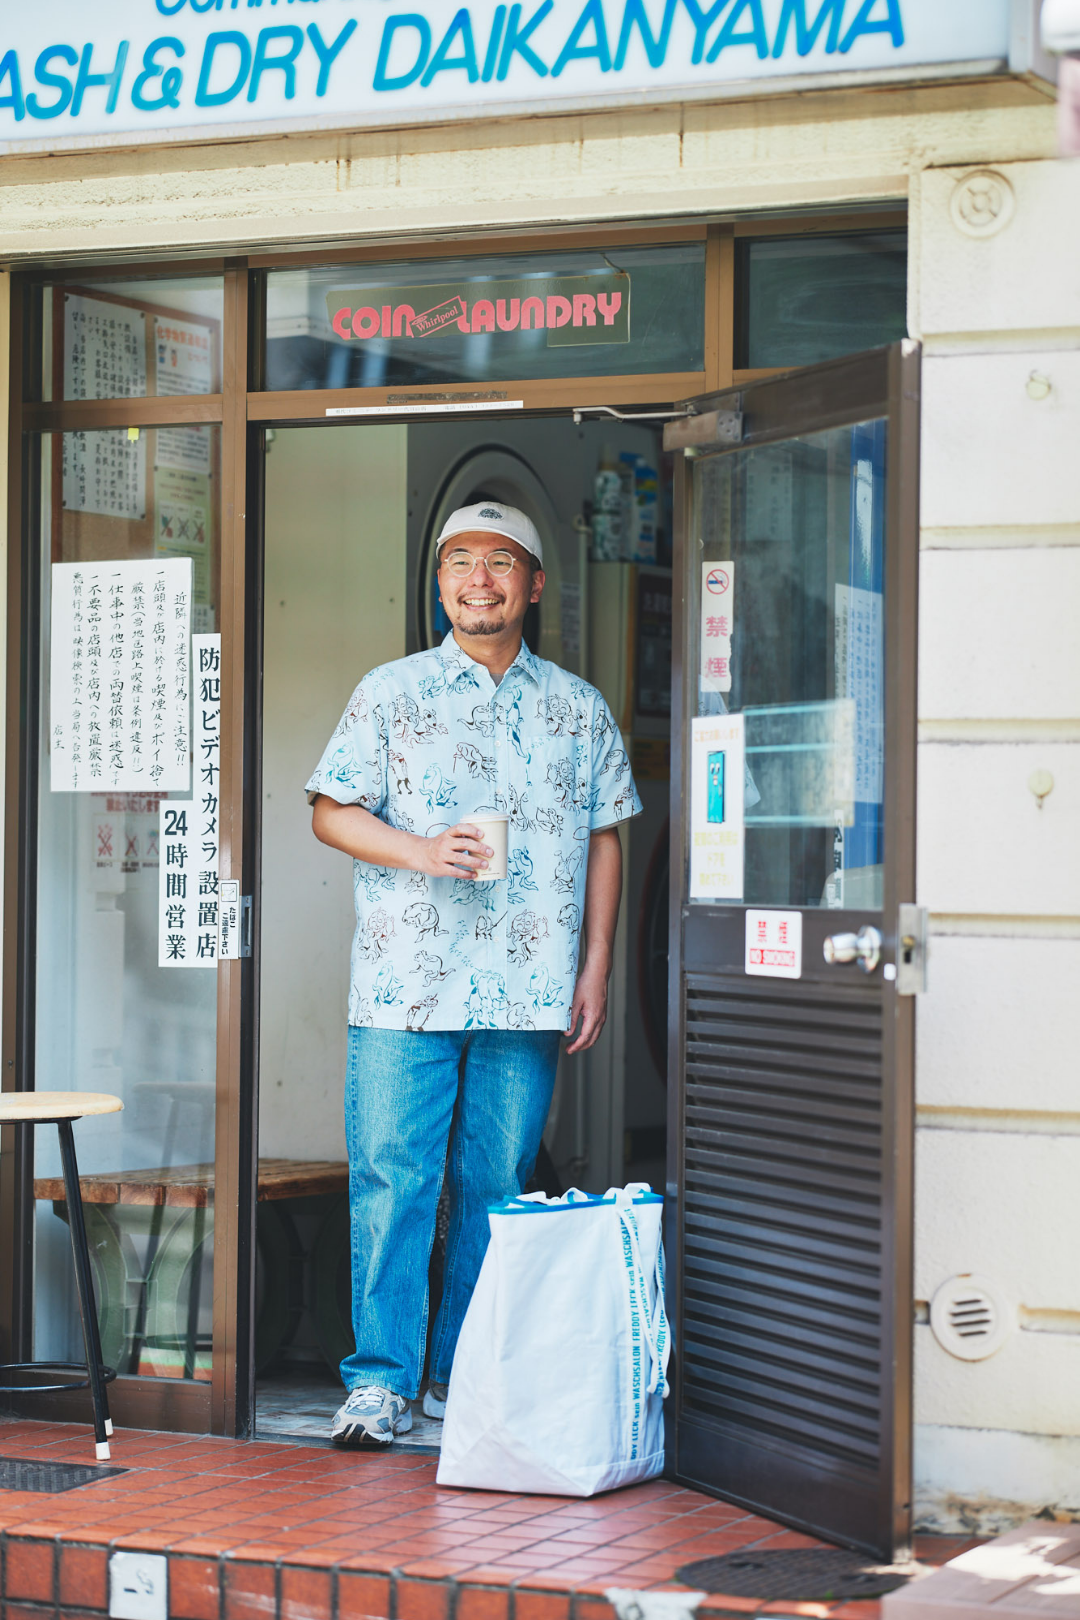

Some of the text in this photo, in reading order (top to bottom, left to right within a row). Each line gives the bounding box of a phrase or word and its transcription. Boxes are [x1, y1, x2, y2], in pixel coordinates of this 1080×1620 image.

[195, 18, 358, 107] DRY
[373, 0, 905, 92] DAIKANYAMA
[332, 292, 622, 340] COIN LAUNDRY
[416, 306, 459, 332] Whirlpool
[704, 615, 728, 678] 禁煙
[53, 724, 65, 750] 店主
[195, 647, 220, 959] 防犯ビデオカメラ設置店
[164, 810, 188, 960] 24時間営業
[631, 1311, 641, 1341] FREDDY
[632, 1345, 641, 1400] WASCHSALON
